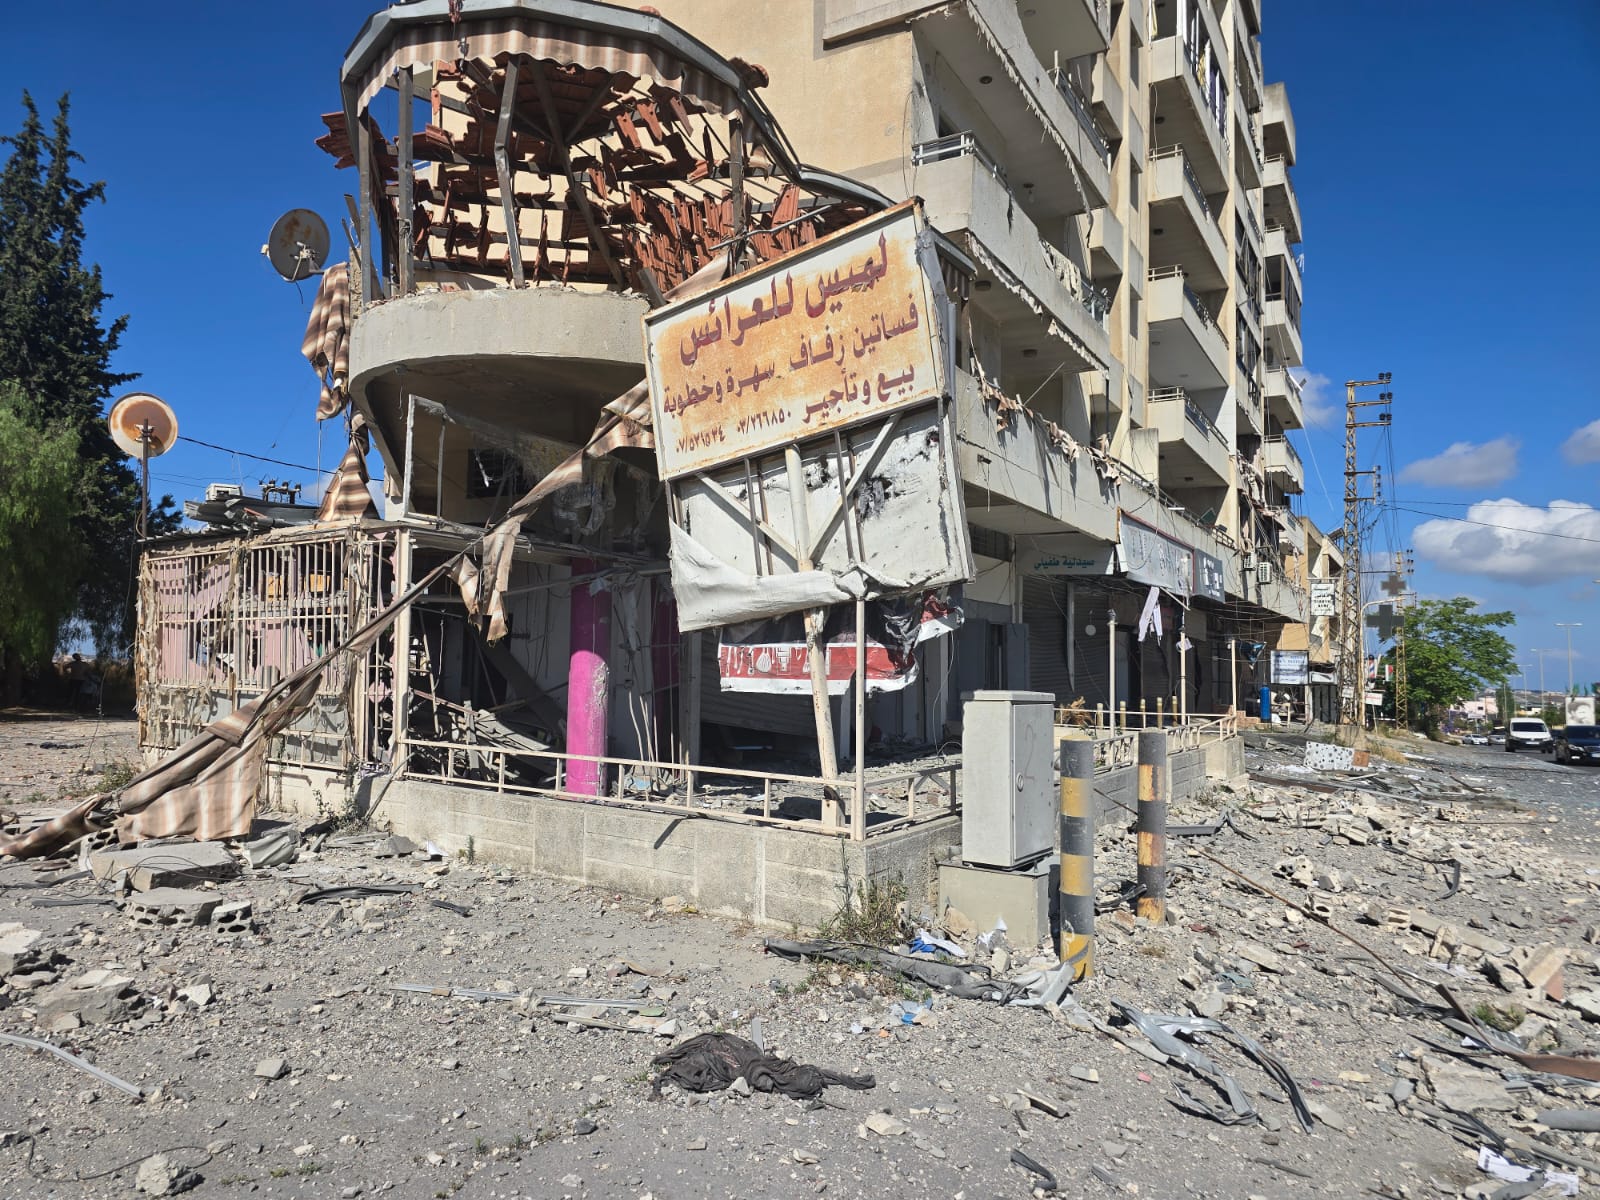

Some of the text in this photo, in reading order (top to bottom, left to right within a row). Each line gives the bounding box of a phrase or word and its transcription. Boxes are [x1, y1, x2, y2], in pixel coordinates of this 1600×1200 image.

[680, 229, 888, 367] لميس للعرائس
[663, 292, 919, 419] فساتين زفاف سهرة وخطوبة
[877, 363, 915, 403] بيع
[1062, 557, 1095, 569] صيدلية
